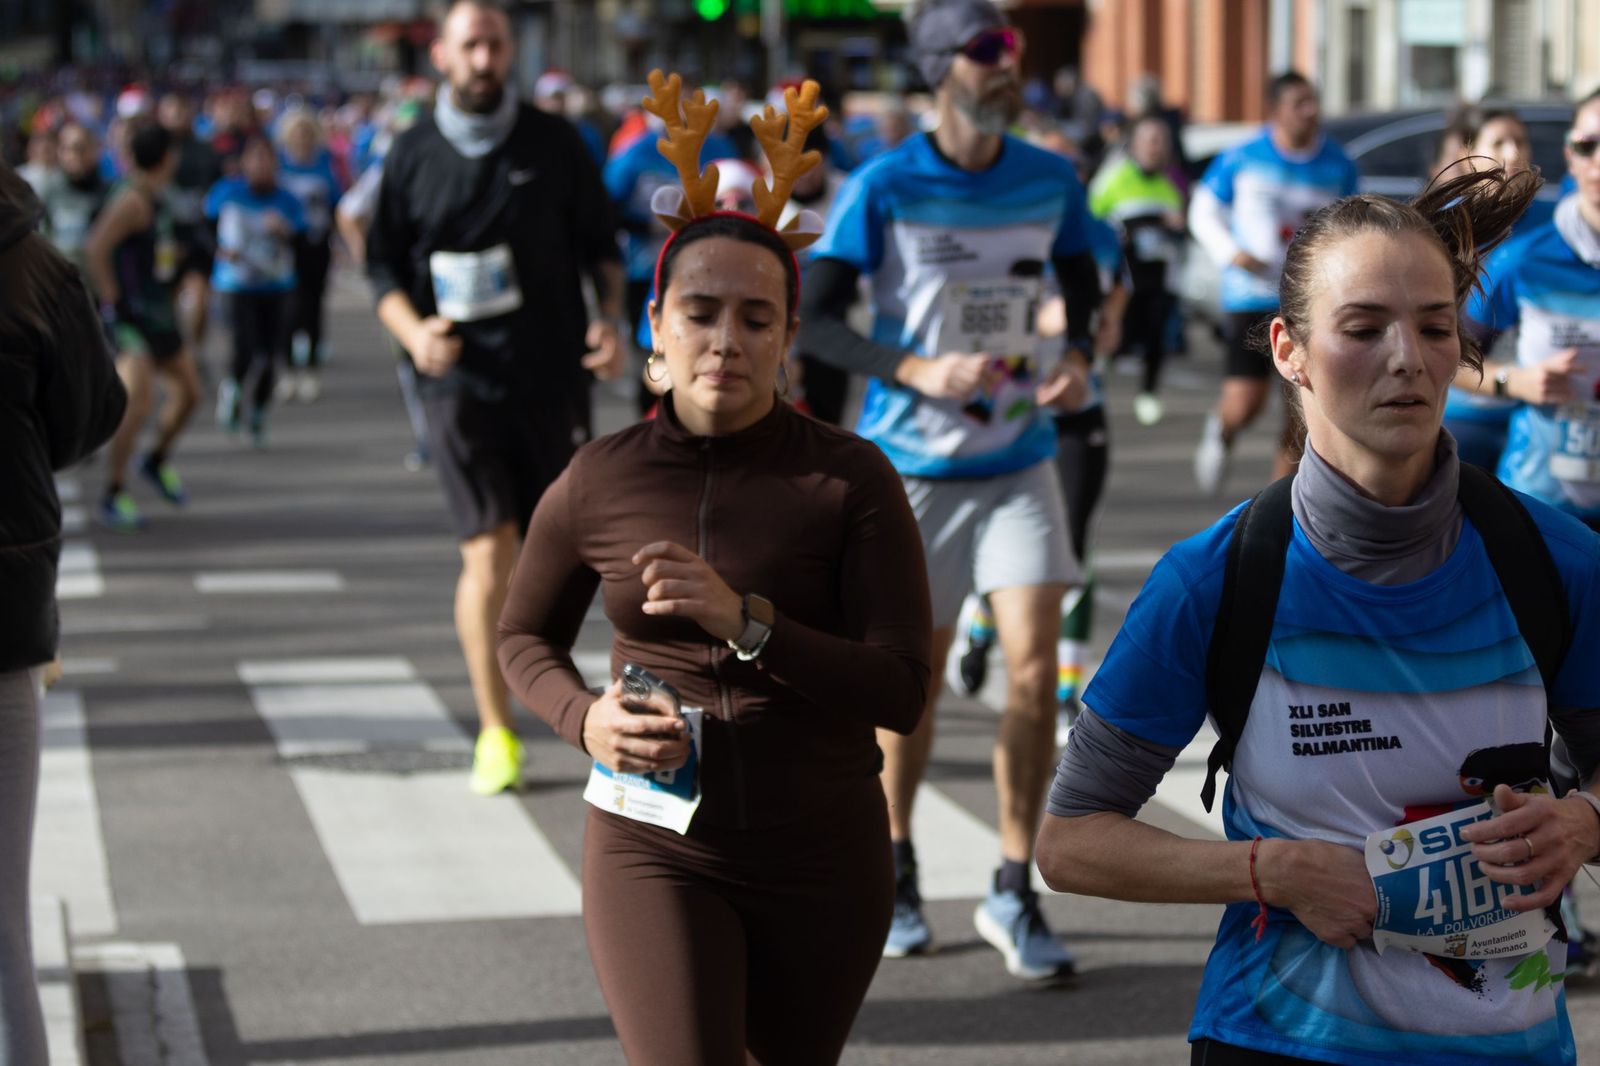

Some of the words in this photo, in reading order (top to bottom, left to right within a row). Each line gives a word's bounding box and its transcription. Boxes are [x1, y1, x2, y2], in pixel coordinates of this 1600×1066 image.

[1288, 705, 1313, 720] XLI
[1317, 702, 1351, 718] SAN
[1290, 719, 1372, 738] SILVESTRE
[1292, 736, 1402, 756] SALMANTINA
[1416, 927, 1435, 937] LA
[1471, 929, 1526, 948] Ayuntamiento
[1483, 941, 1528, 956] Salamanca
